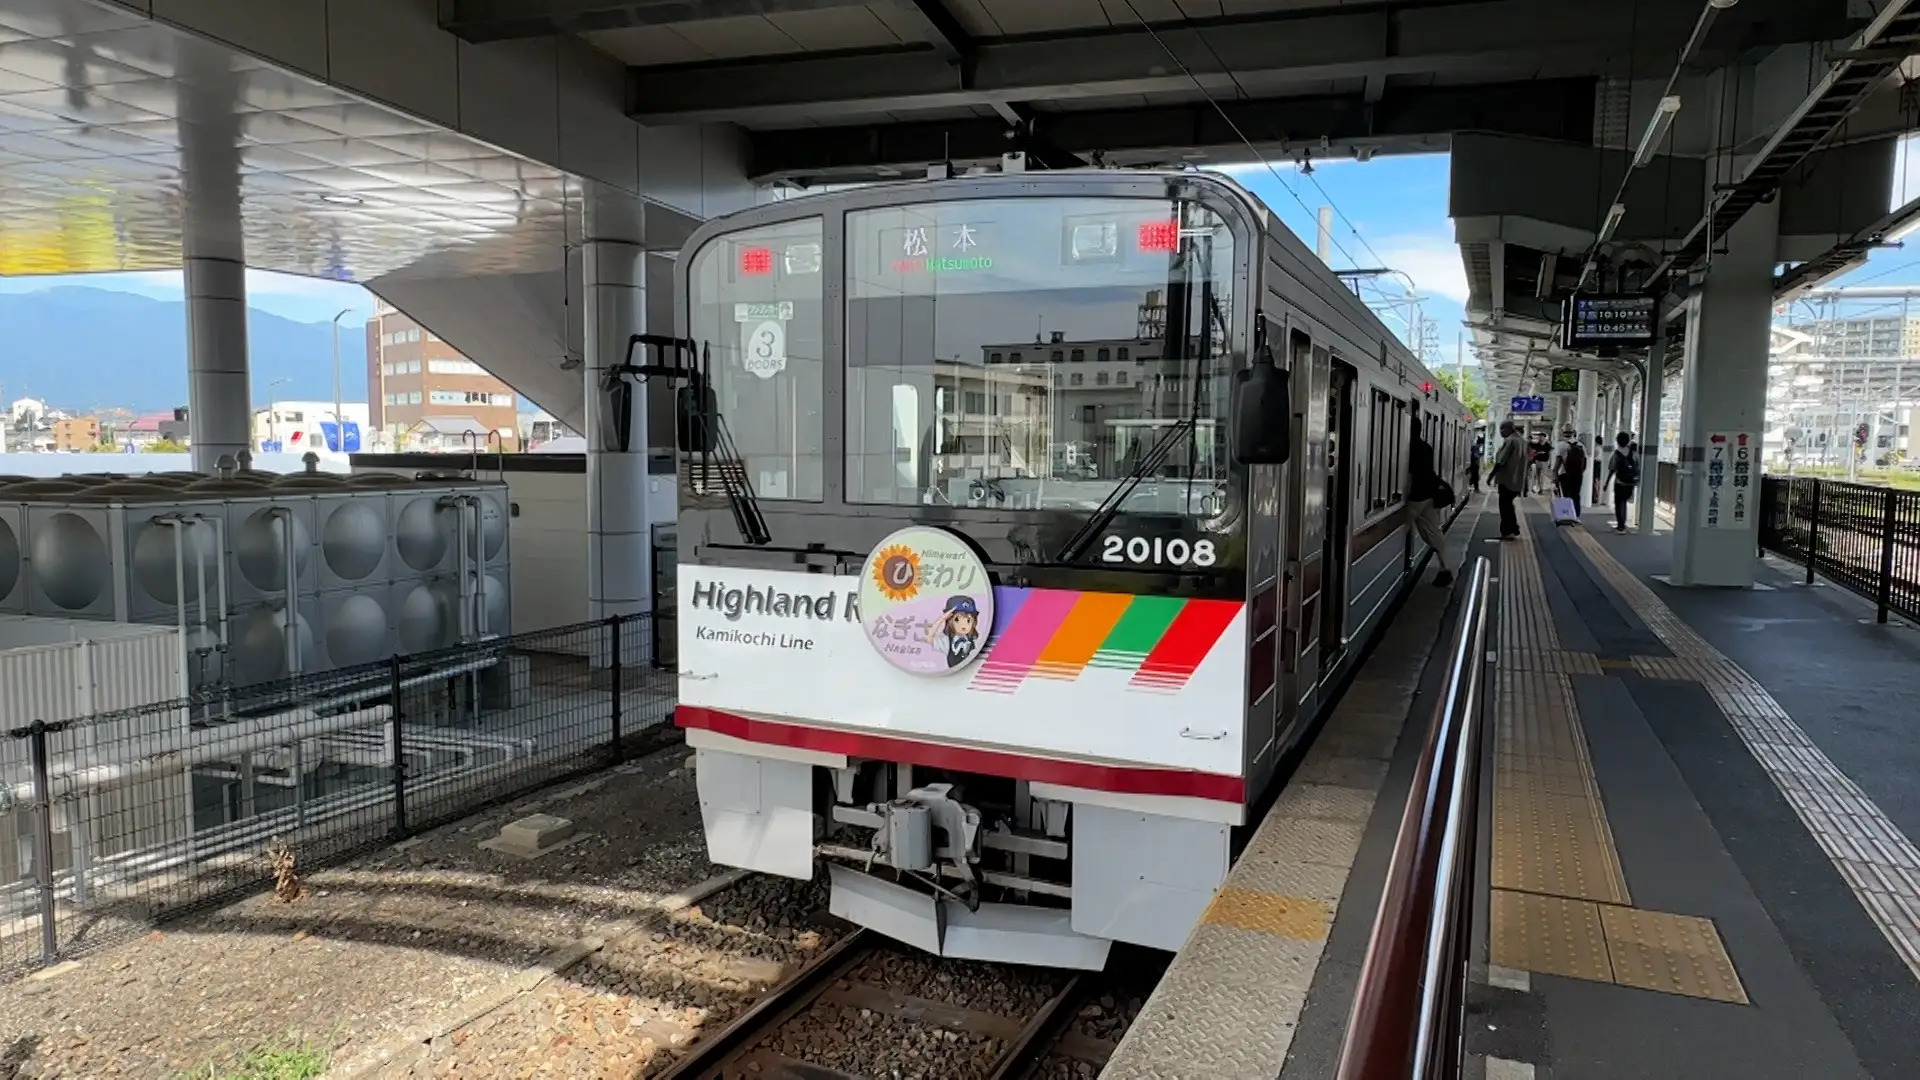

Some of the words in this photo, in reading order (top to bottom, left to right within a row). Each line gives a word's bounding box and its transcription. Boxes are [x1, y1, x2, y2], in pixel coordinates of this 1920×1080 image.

[756, 331, 775, 358] 3
[1102, 534, 1216, 567] 20108
[893, 560, 977, 590] ひまわり
[692, 580, 837, 622] Highland
[695, 625, 776, 647] Kamikochi
[780, 633, 814, 650] Line
[872, 614, 935, 644] なぎさ
